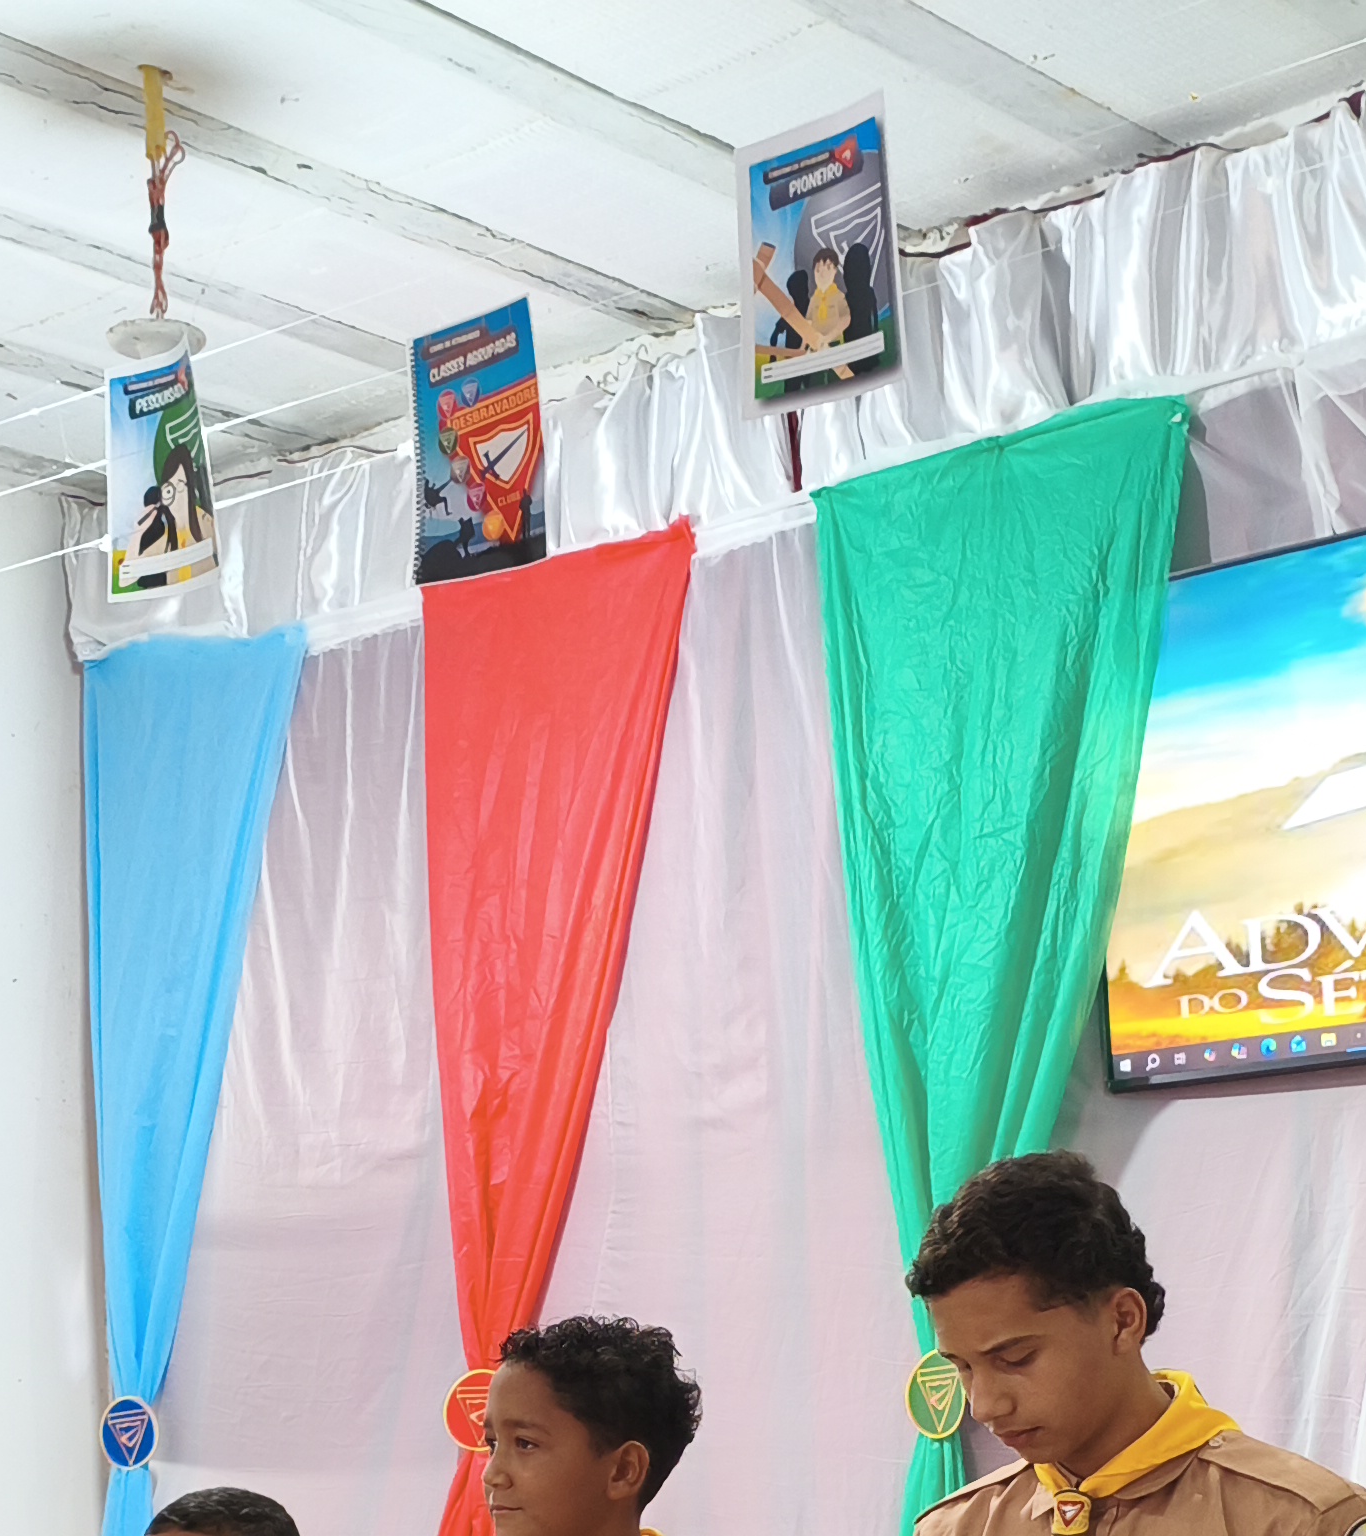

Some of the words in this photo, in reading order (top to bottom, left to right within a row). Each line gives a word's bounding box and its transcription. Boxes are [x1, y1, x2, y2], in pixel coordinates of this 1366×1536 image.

[789, 161, 843, 199] PIONEIRO
[429, 356, 465, 383] CLASSES
[452, 385, 537, 430] DESBRAVADORE
[1179, 986, 1248, 1019] DO
